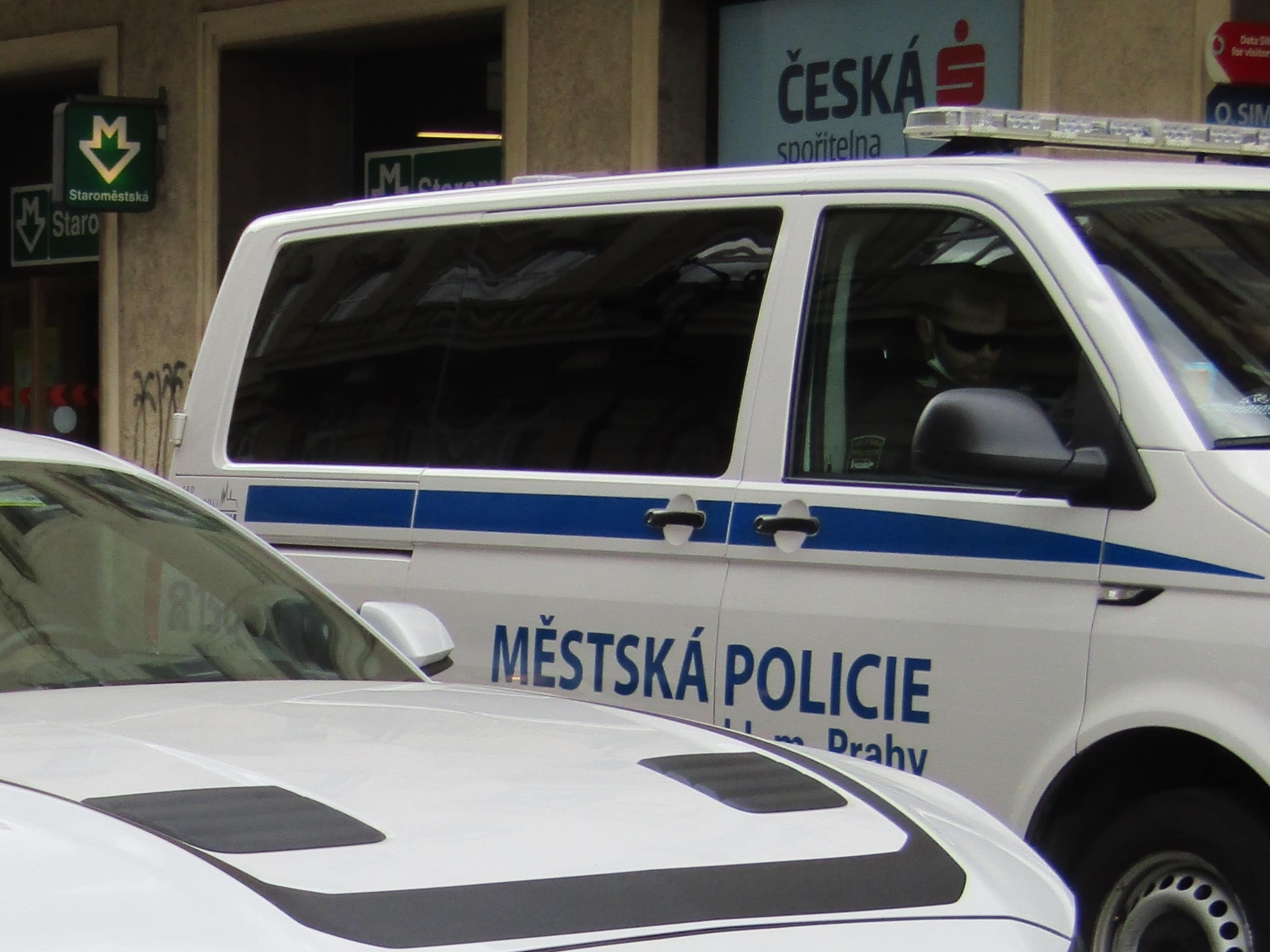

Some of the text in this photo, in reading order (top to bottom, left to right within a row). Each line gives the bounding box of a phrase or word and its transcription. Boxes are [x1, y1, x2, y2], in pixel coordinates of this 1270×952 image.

[1231, 47, 1244, 57] for
[778, 34, 925, 124] ČESKÁ
[777, 131, 880, 164] spořitelna
[69, 189, 149, 202] Staroměstská
[53, 210, 99, 238] Staro
[491, 614, 932, 724] MĚSTSKÁ POLICIE
